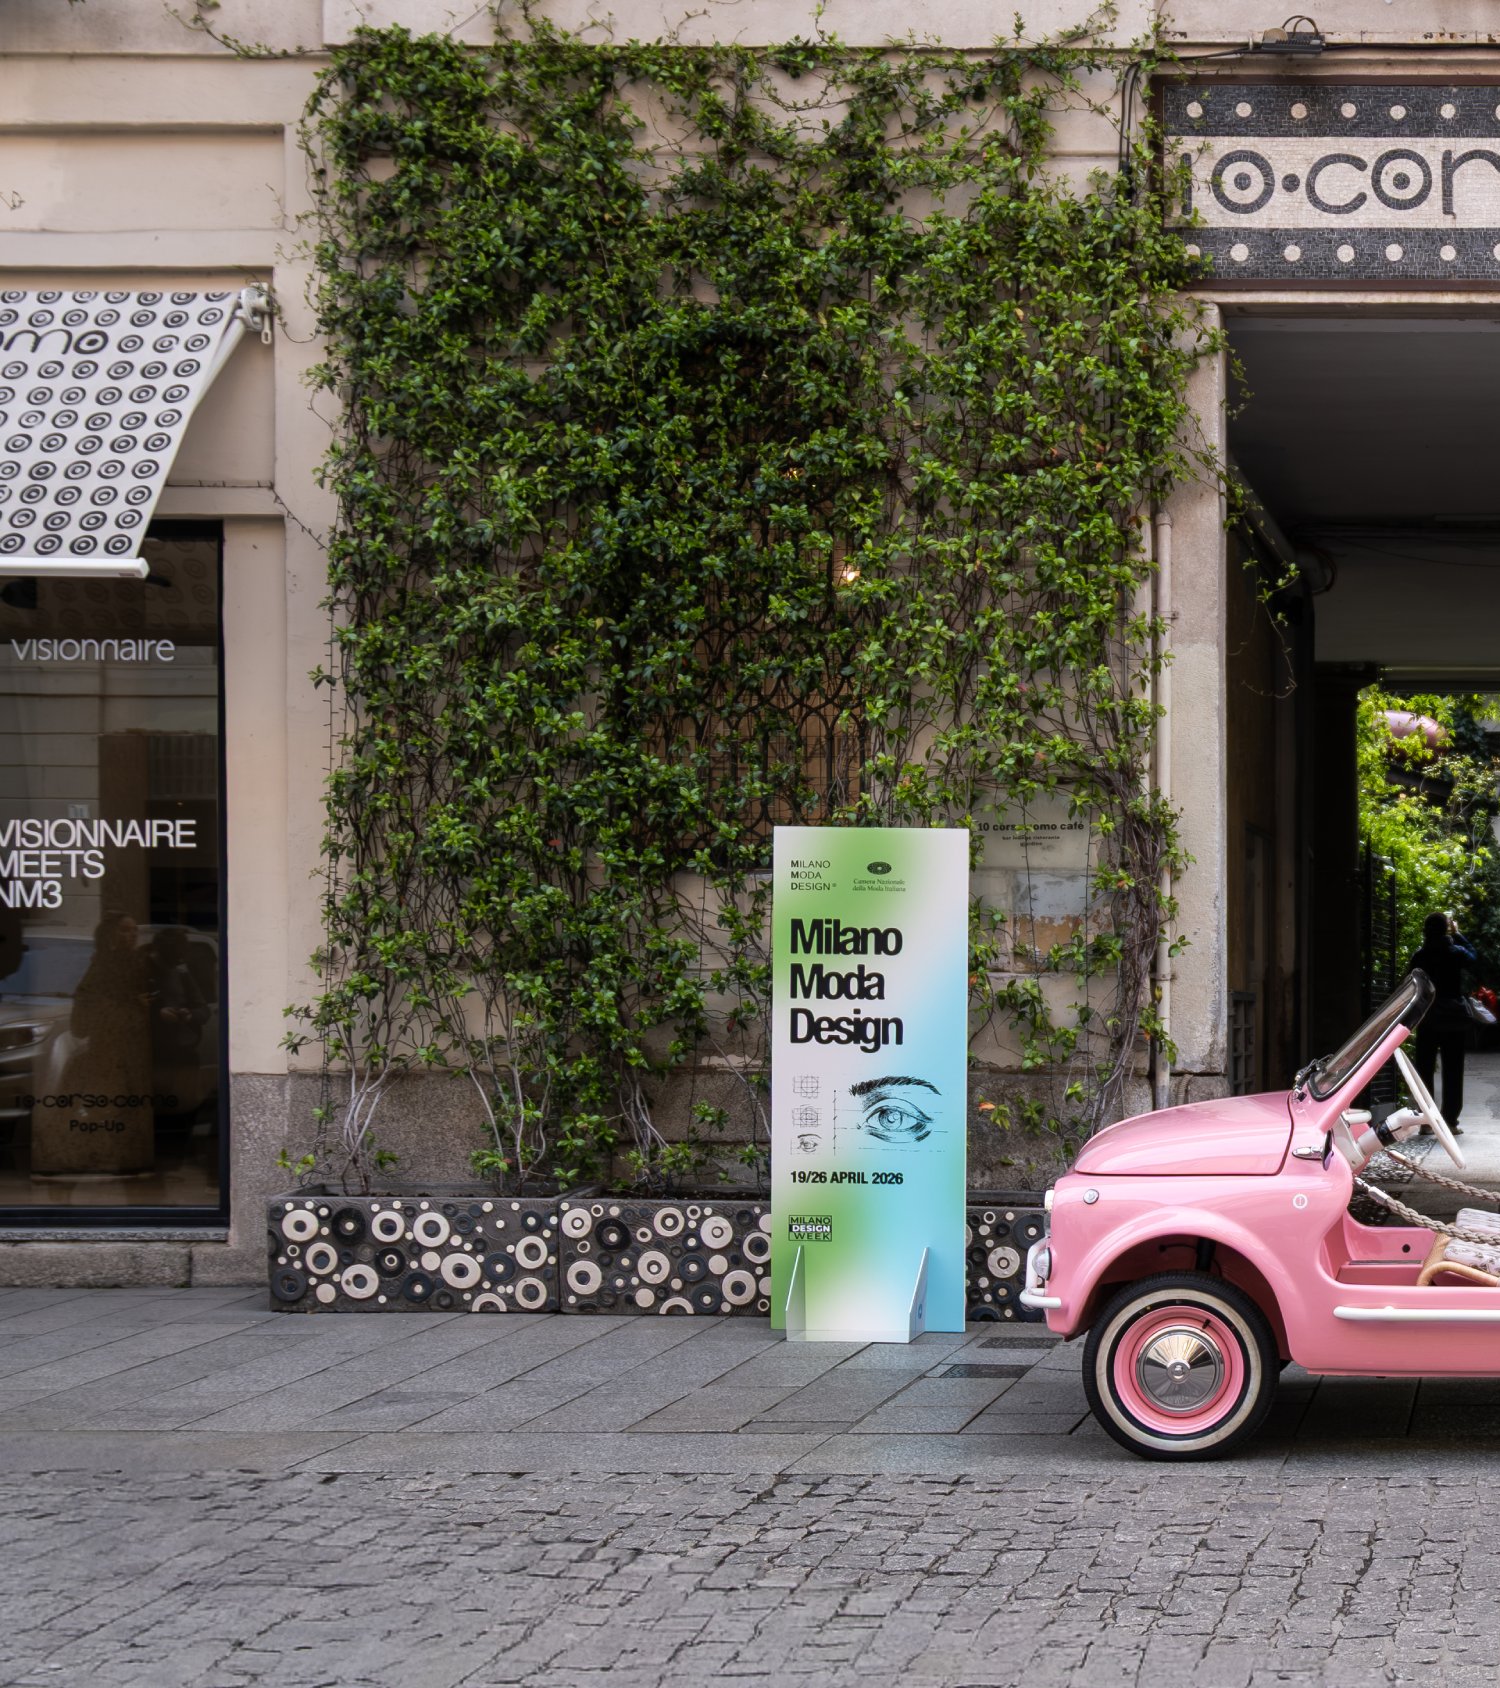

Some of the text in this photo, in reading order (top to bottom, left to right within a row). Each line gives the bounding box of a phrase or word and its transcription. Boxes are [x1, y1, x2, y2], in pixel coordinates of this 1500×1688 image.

[11, 638, 175, 662] visionnaire
[978, 821, 1084, 831] 10 cors omo café
[0, 850, 105, 879] MEETS
[791, 860, 831, 868] MILANO
[791, 871, 822, 879] MODA
[790, 918, 903, 956] Milano
[790, 963, 885, 1000] Moda
[790, 1008, 903, 1053] Design
[69, 1120, 125, 1132] Pop-Up
[790, 1171, 904, 1185] 19/26 APRIL 2026
[794, 1232, 830, 1240] WEEK
